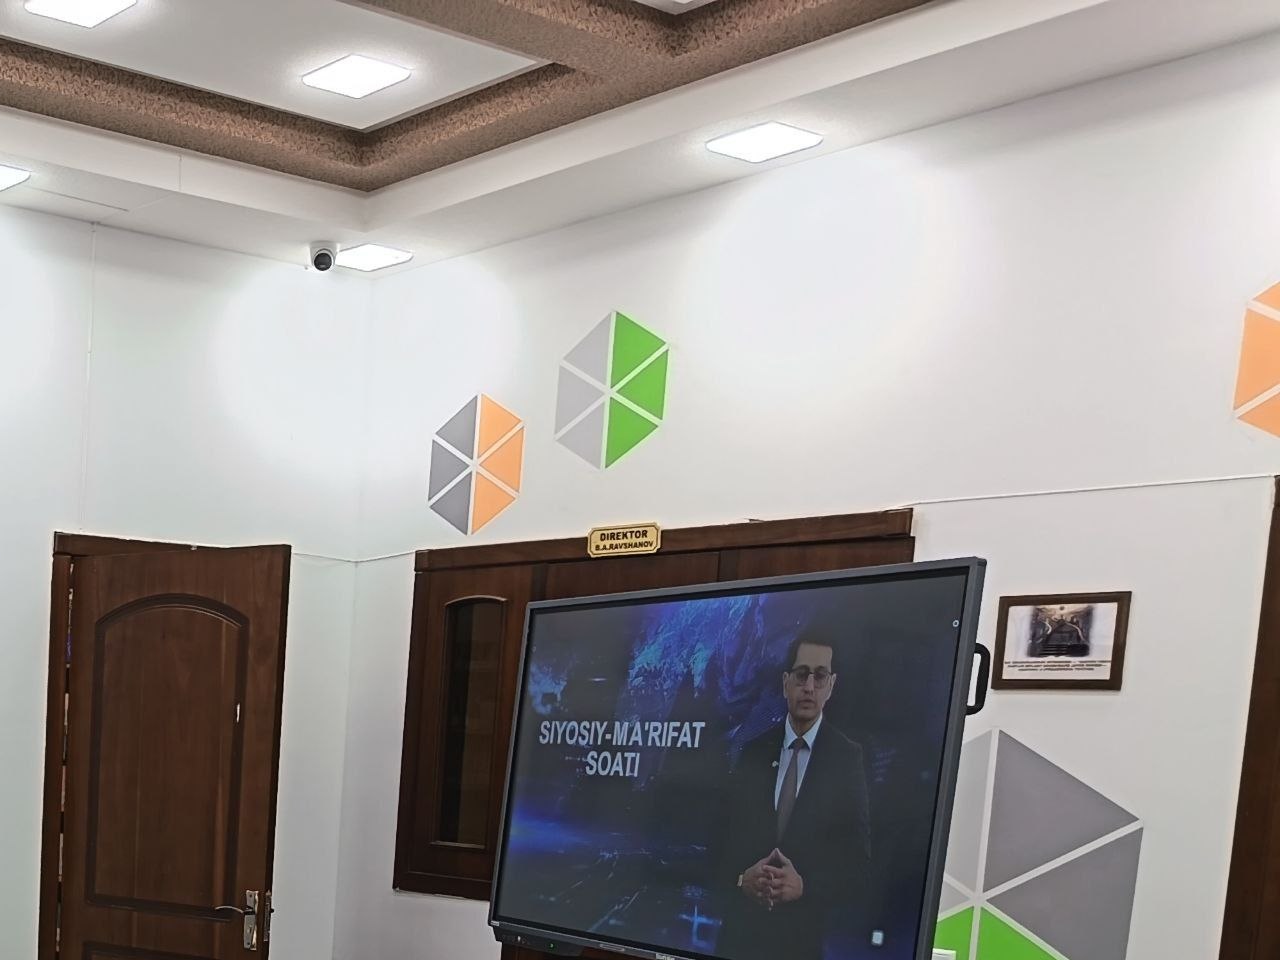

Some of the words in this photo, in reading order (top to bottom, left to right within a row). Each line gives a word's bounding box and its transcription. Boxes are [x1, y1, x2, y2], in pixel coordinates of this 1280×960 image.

[600, 529, 648, 541] DIREKTOR
[539, 720, 706, 748] SIYOSIY-MA'RIFAT
[585, 750, 641, 777] SOATI
